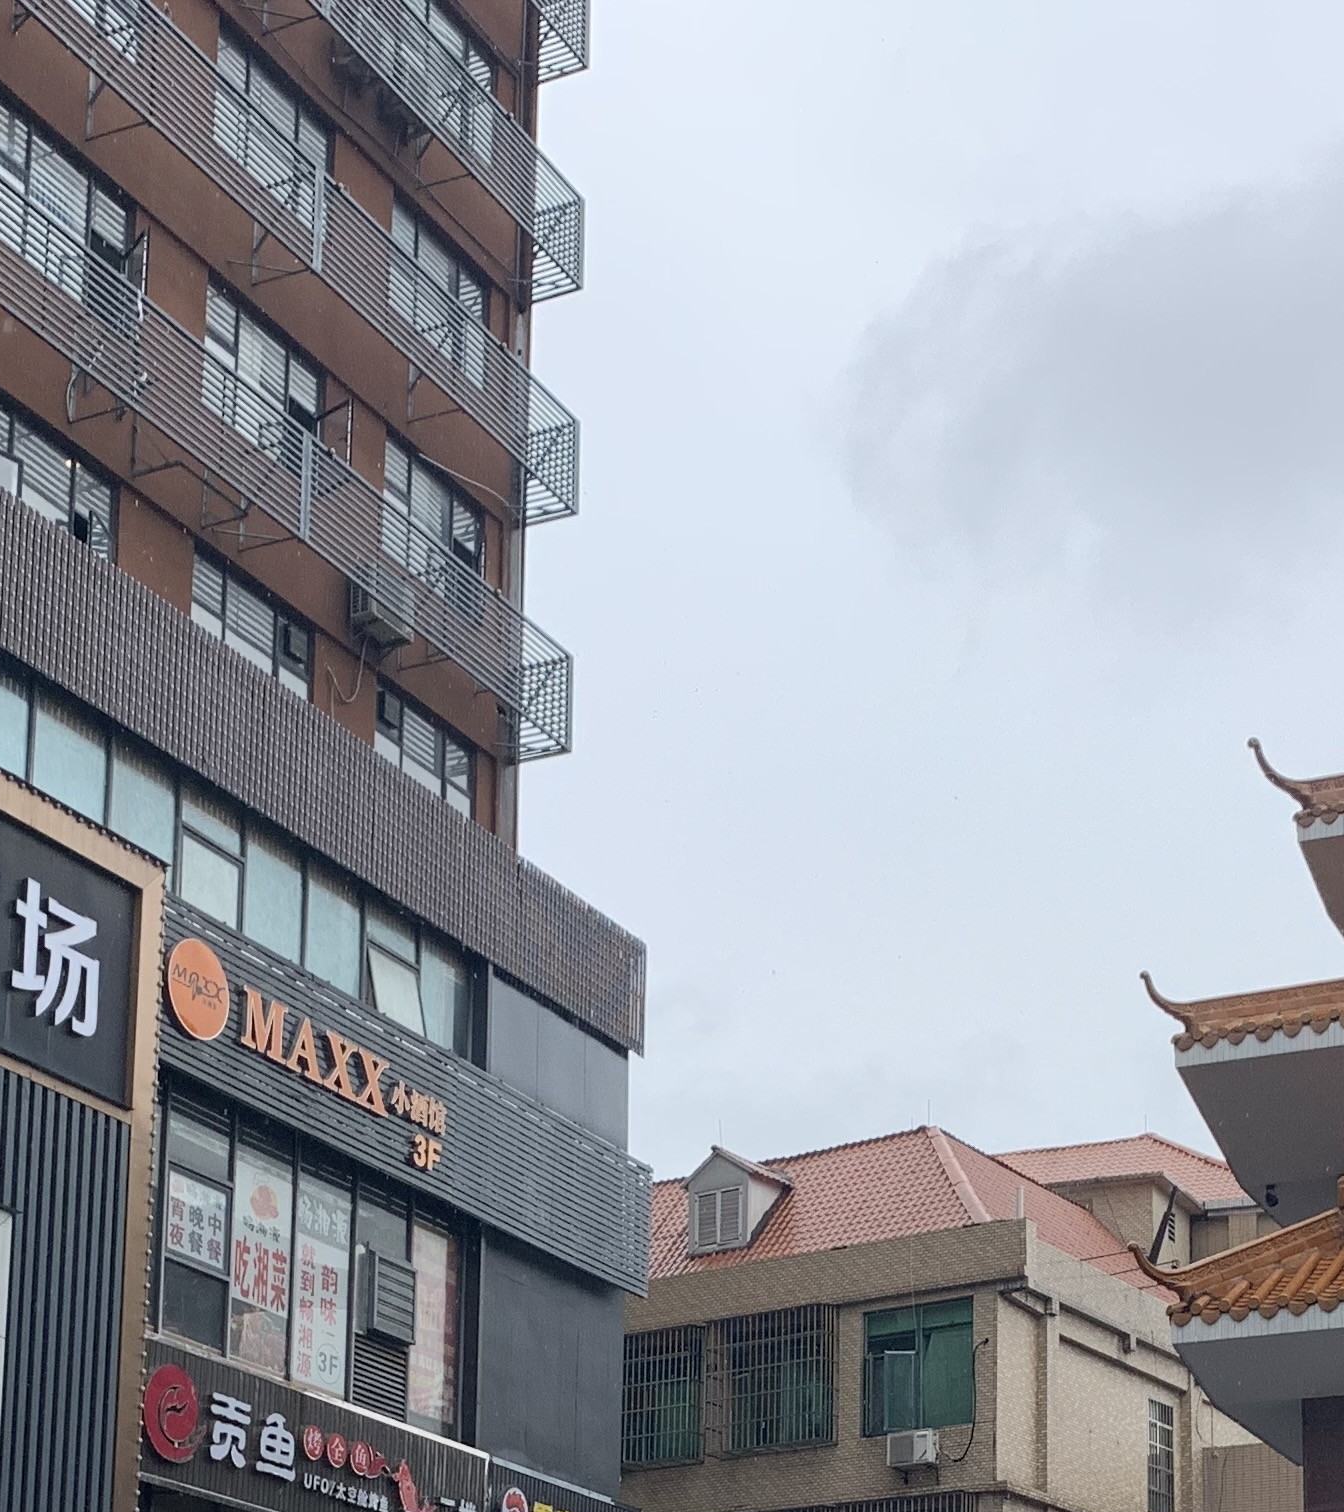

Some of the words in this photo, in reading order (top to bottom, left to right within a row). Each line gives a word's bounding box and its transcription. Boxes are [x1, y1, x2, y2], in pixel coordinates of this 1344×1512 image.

[240, 983, 391, 1118] MAXX
[391, 1079, 448, 1136] 小酒馆
[412, 1134, 443, 1172] 3F
[188, 1205, 205, 1257] 晚餐
[207, 1213, 223, 1264] 中餐
[234, 1234, 288, 1312] 吃湘菜
[317, 1351, 339, 1376] 3F
[209, 1391, 297, 1483] 贡鱼
[304, 1425, 371, 1475] 烤全鱼
